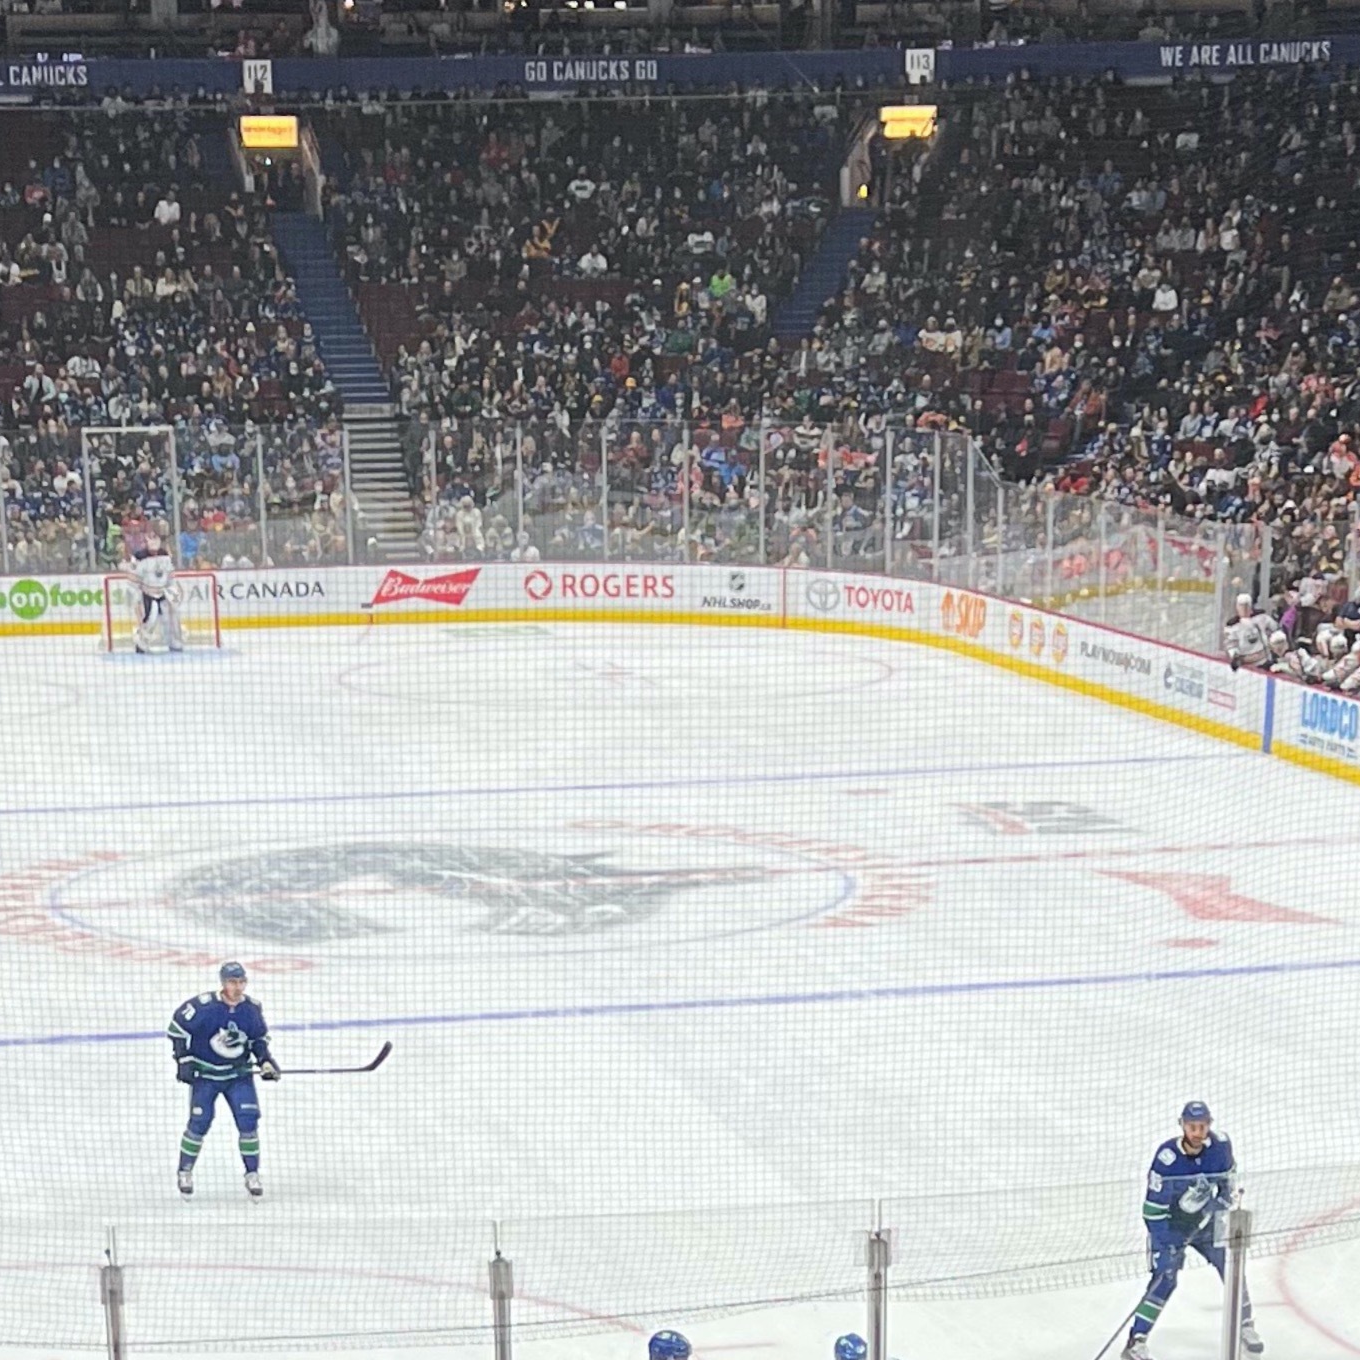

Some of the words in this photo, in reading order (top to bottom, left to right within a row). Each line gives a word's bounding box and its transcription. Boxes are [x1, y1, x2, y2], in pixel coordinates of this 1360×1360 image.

[910, 54, 930, 70] 113
[1160, 46, 1184, 67] WE
[1189, 45, 1221, 66] ARE
[1226, 44, 1254, 65] ALL
[1259, 41, 1331, 63] CANUCKS
[9, 65, 88, 86] CANUCKS
[247, 64, 268, 81] 112
[525, 61, 547, 81] GO
[553, 60, 629, 81] CANUCKS
[635, 60, 657, 80] GO
[230, 581, 325, 600] CANADA
[381, 577, 472, 597] Budweiser
[561, 574, 675, 599] ROGERS
[844, 585, 914, 614] TOYOTA
[955, 594, 987, 638] SKIP
[1301, 691, 1360, 742] LORDCO
